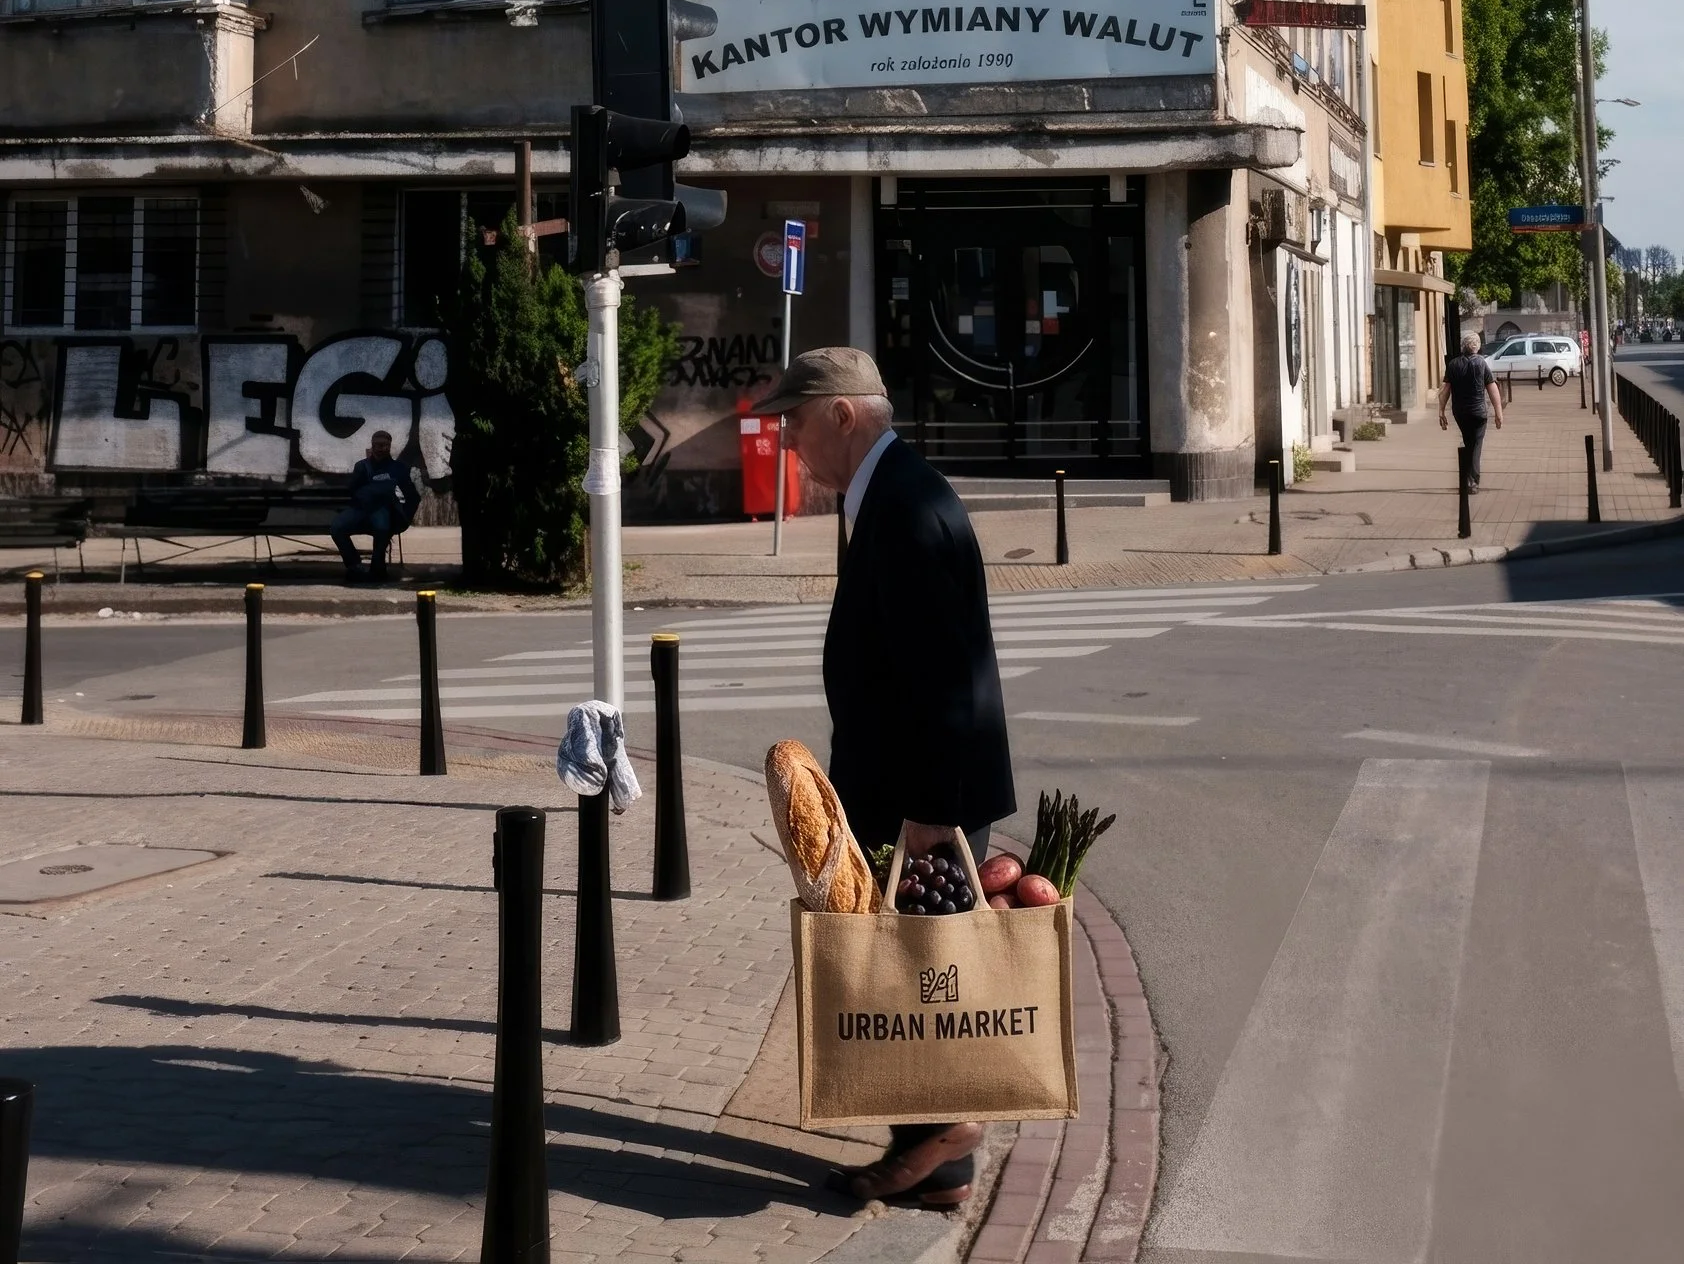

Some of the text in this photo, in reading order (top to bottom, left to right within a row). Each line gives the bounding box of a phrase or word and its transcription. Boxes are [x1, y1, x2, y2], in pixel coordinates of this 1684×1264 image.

[691, 6, 1204, 80] KANTOR WYMIANY WALUT
[870, 56, 895, 72] rok
[977, 52, 1014, 69] 1990
[837, 1006, 1039, 1042] URBAN MARKET
